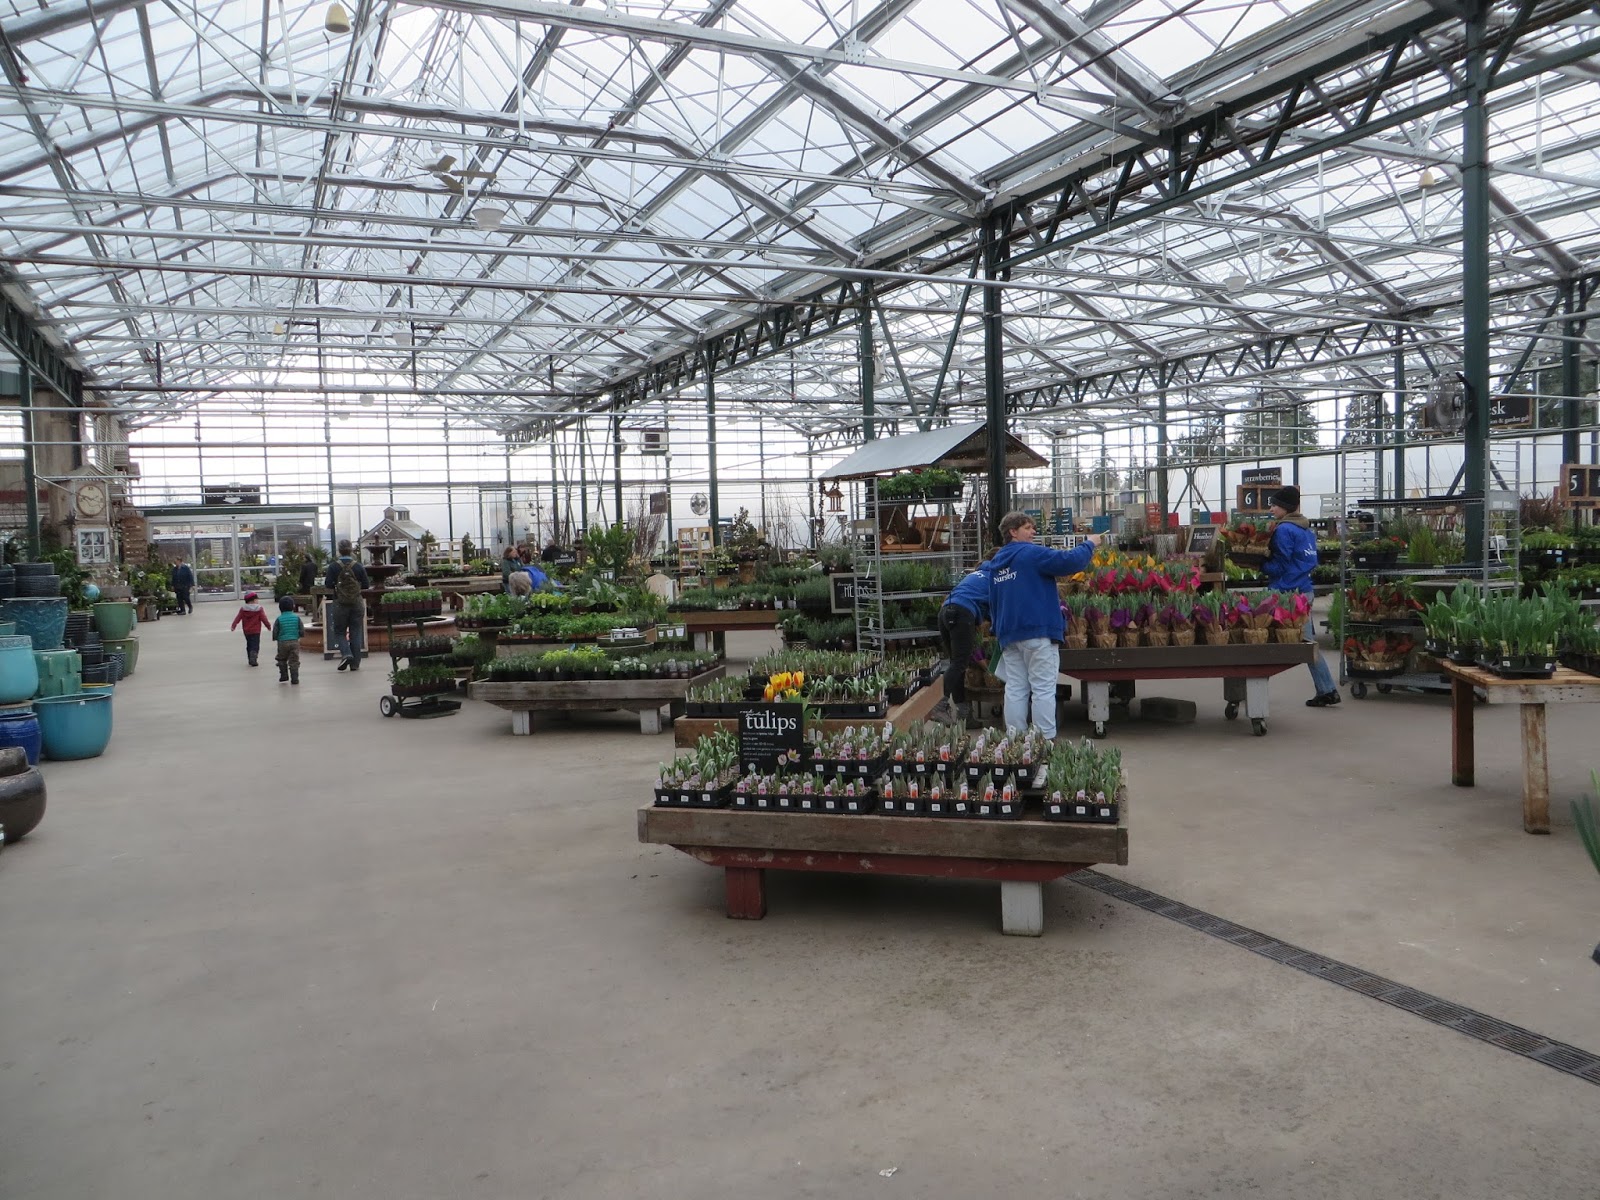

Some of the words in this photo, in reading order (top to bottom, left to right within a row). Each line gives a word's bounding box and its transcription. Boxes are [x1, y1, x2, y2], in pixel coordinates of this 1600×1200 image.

[1489, 400, 1506, 416] sk
[1244, 472, 1279, 483] strawberries
[1570, 474, 1578, 491] 5
[1245, 492, 1252, 505] 6
[993, 571, 1018, 585] Nursery
[745, 709, 797, 736] tulips
